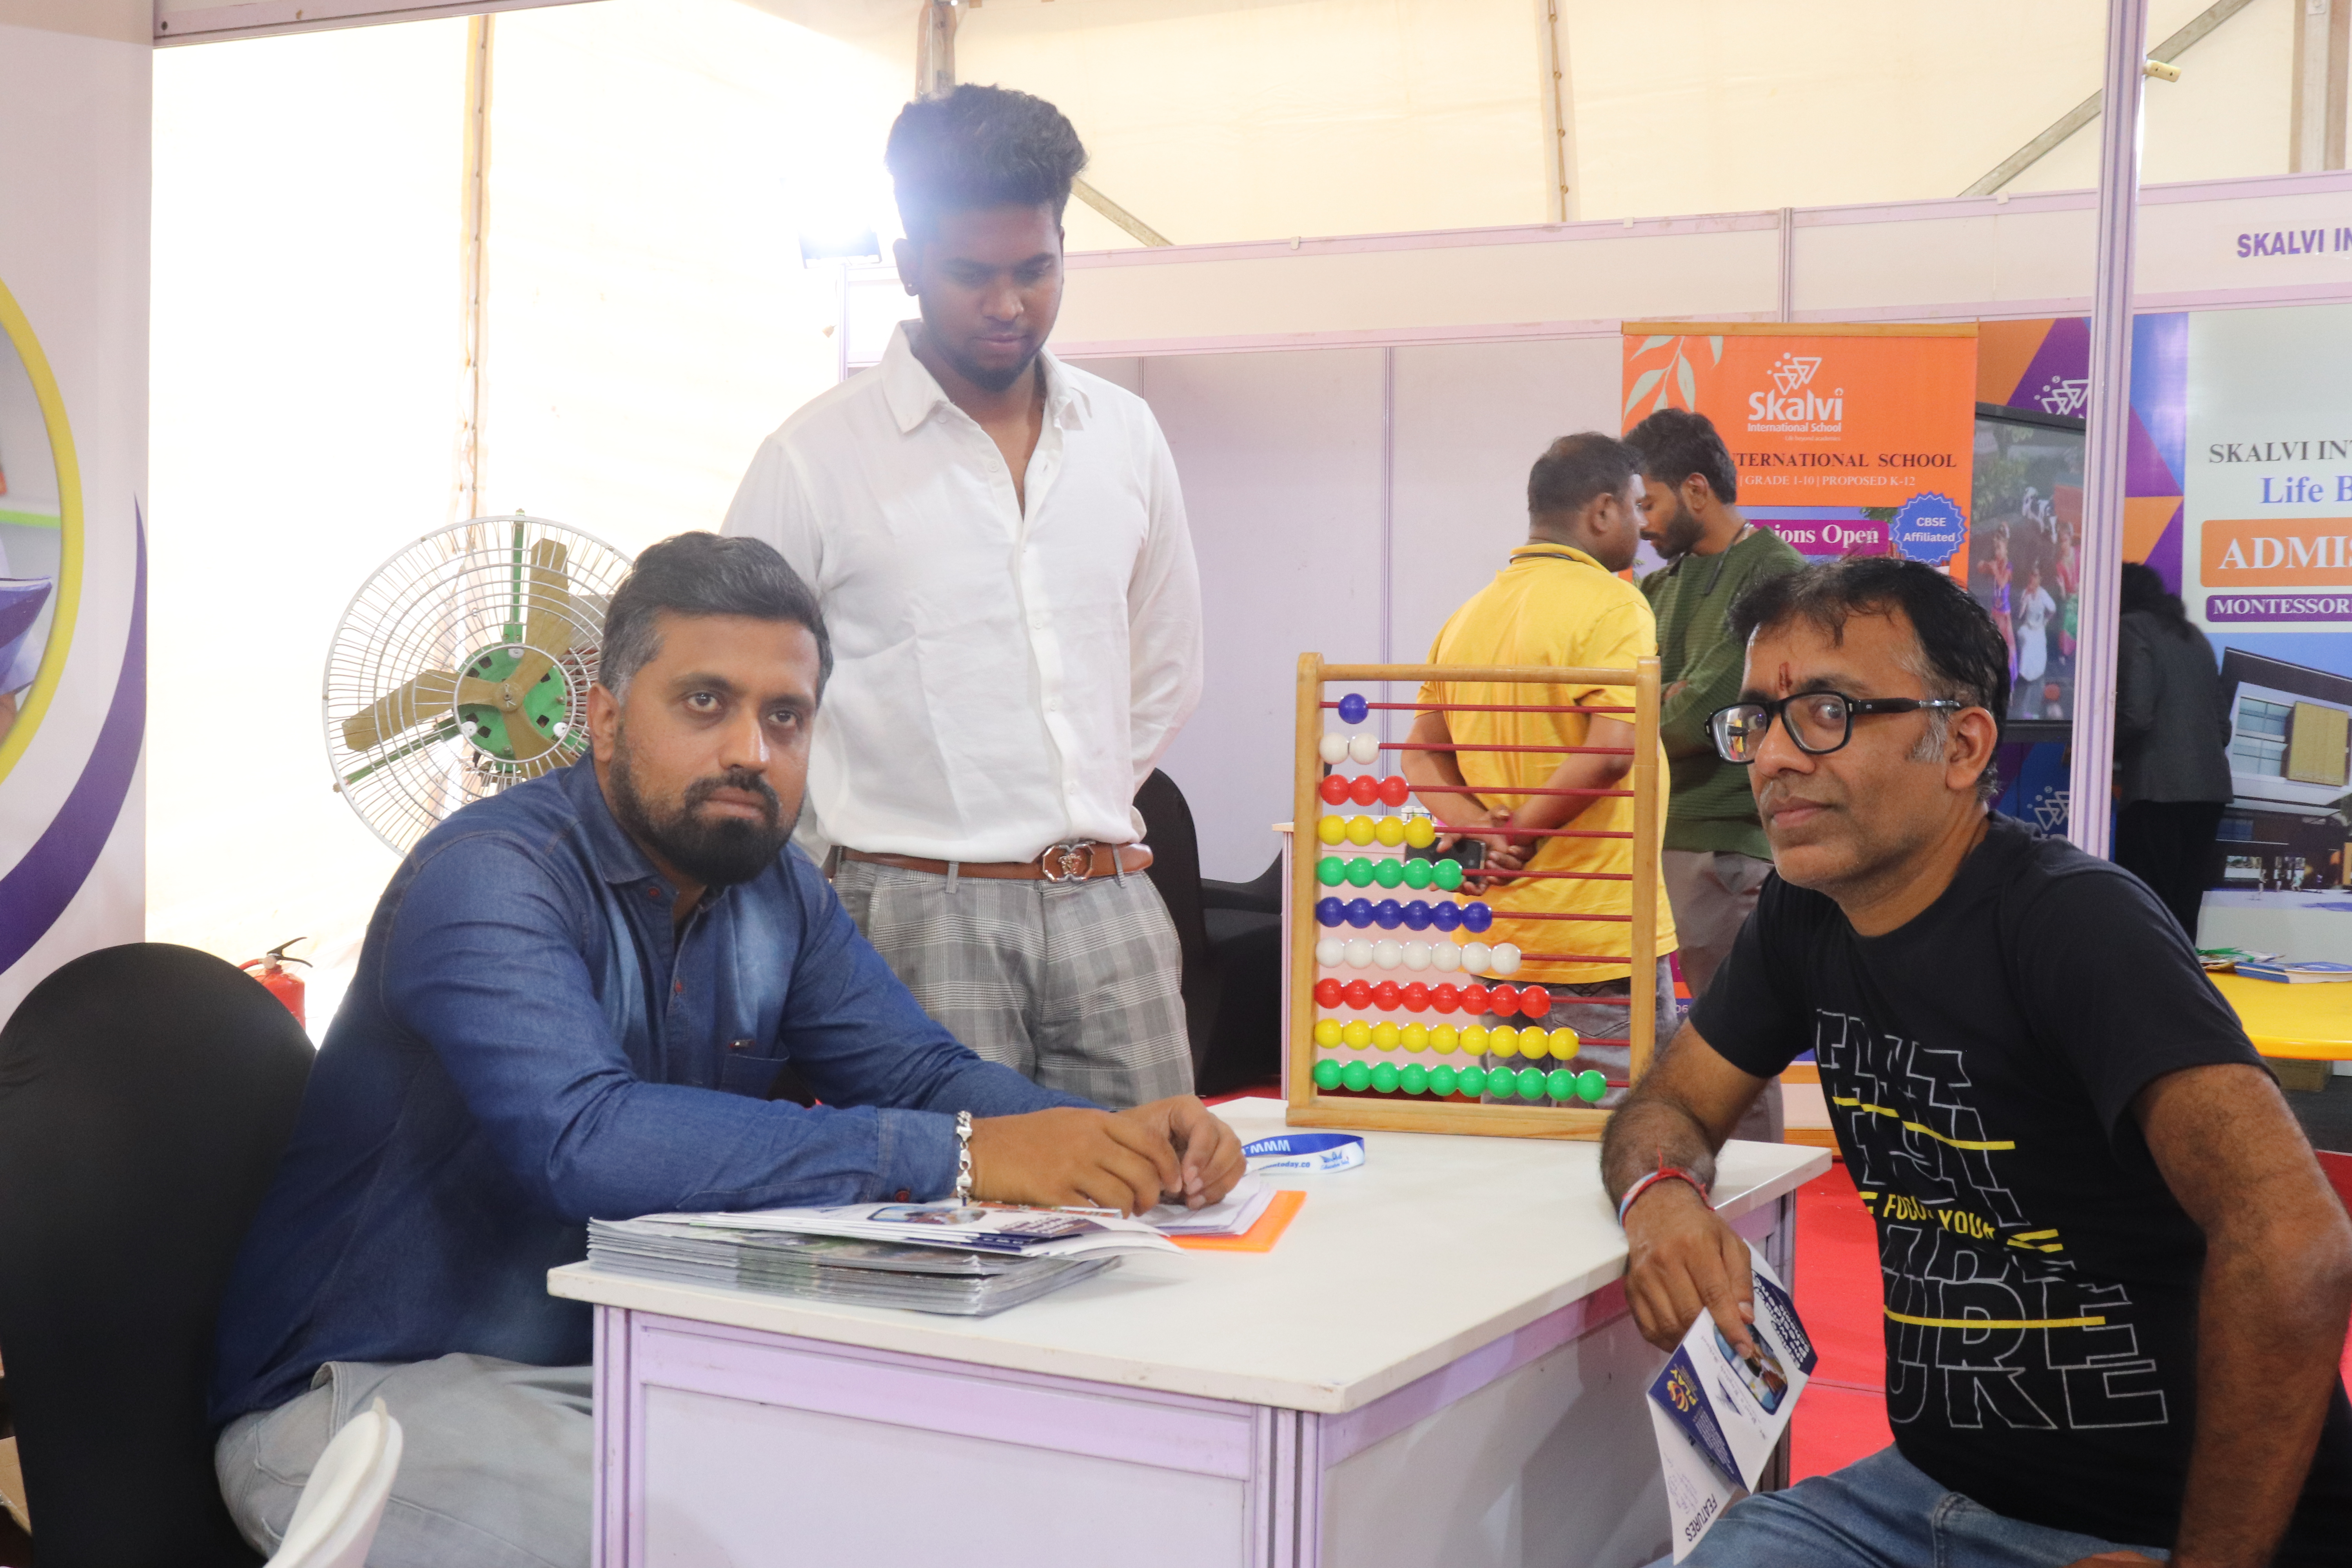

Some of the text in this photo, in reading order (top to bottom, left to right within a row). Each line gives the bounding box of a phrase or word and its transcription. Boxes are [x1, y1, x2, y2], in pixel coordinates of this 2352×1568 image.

[2237, 229, 2325, 258] SKALVI
[1748, 388, 1844, 421] Skalvi
[1748, 422, 1842, 432] International School
[1732, 453, 1957, 468] TERNATIONAL SCHOOL
[2209, 441, 2310, 463] SKALVI
[1745, 475, 1789, 485] GRADE
[1822, 476, 1887, 486] PROPOSED
[1889, 477, 1916, 486] K-12
[2260, 476, 2324, 503] Life
[1916, 517, 1947, 527] CBSE
[1822, 524, 1879, 548] Open
[1902, 532, 1955, 543] Affiliated
[2218, 535, 2352, 570] ADMI
[2213, 598, 2352, 615] MONTESSOR
[1883, 1194, 1933, 1221] FOCU
[1685, 1493, 1718, 1542] FEATURES
